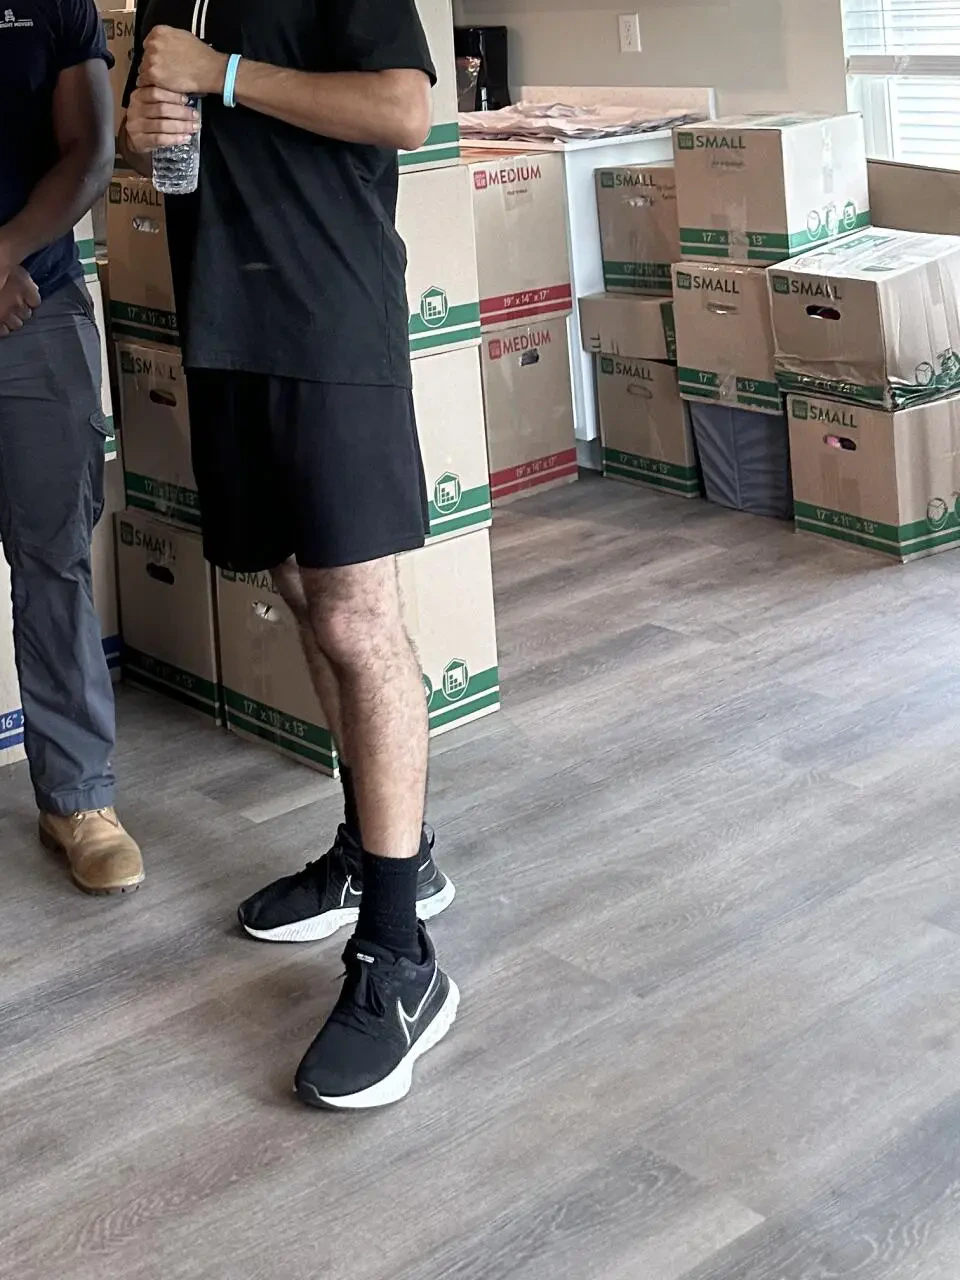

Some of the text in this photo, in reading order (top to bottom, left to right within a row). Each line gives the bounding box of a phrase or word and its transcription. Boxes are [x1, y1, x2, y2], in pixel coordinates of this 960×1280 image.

[696, 135, 747, 150] SMALL
[488, 164, 542, 186] MEDIUM
[615, 174, 657, 188] SMALL
[123, 186, 162, 207] SMALL
[693, 275, 740, 294] SMALL
[791, 279, 842, 300] SMALL
[168, 314, 177, 328] 13
[502, 330, 552, 355] MEDIUM
[615, 362, 654, 382] SMALL
[810, 405, 858, 428] SMALL
[1, 713, 18, 730] 16"
